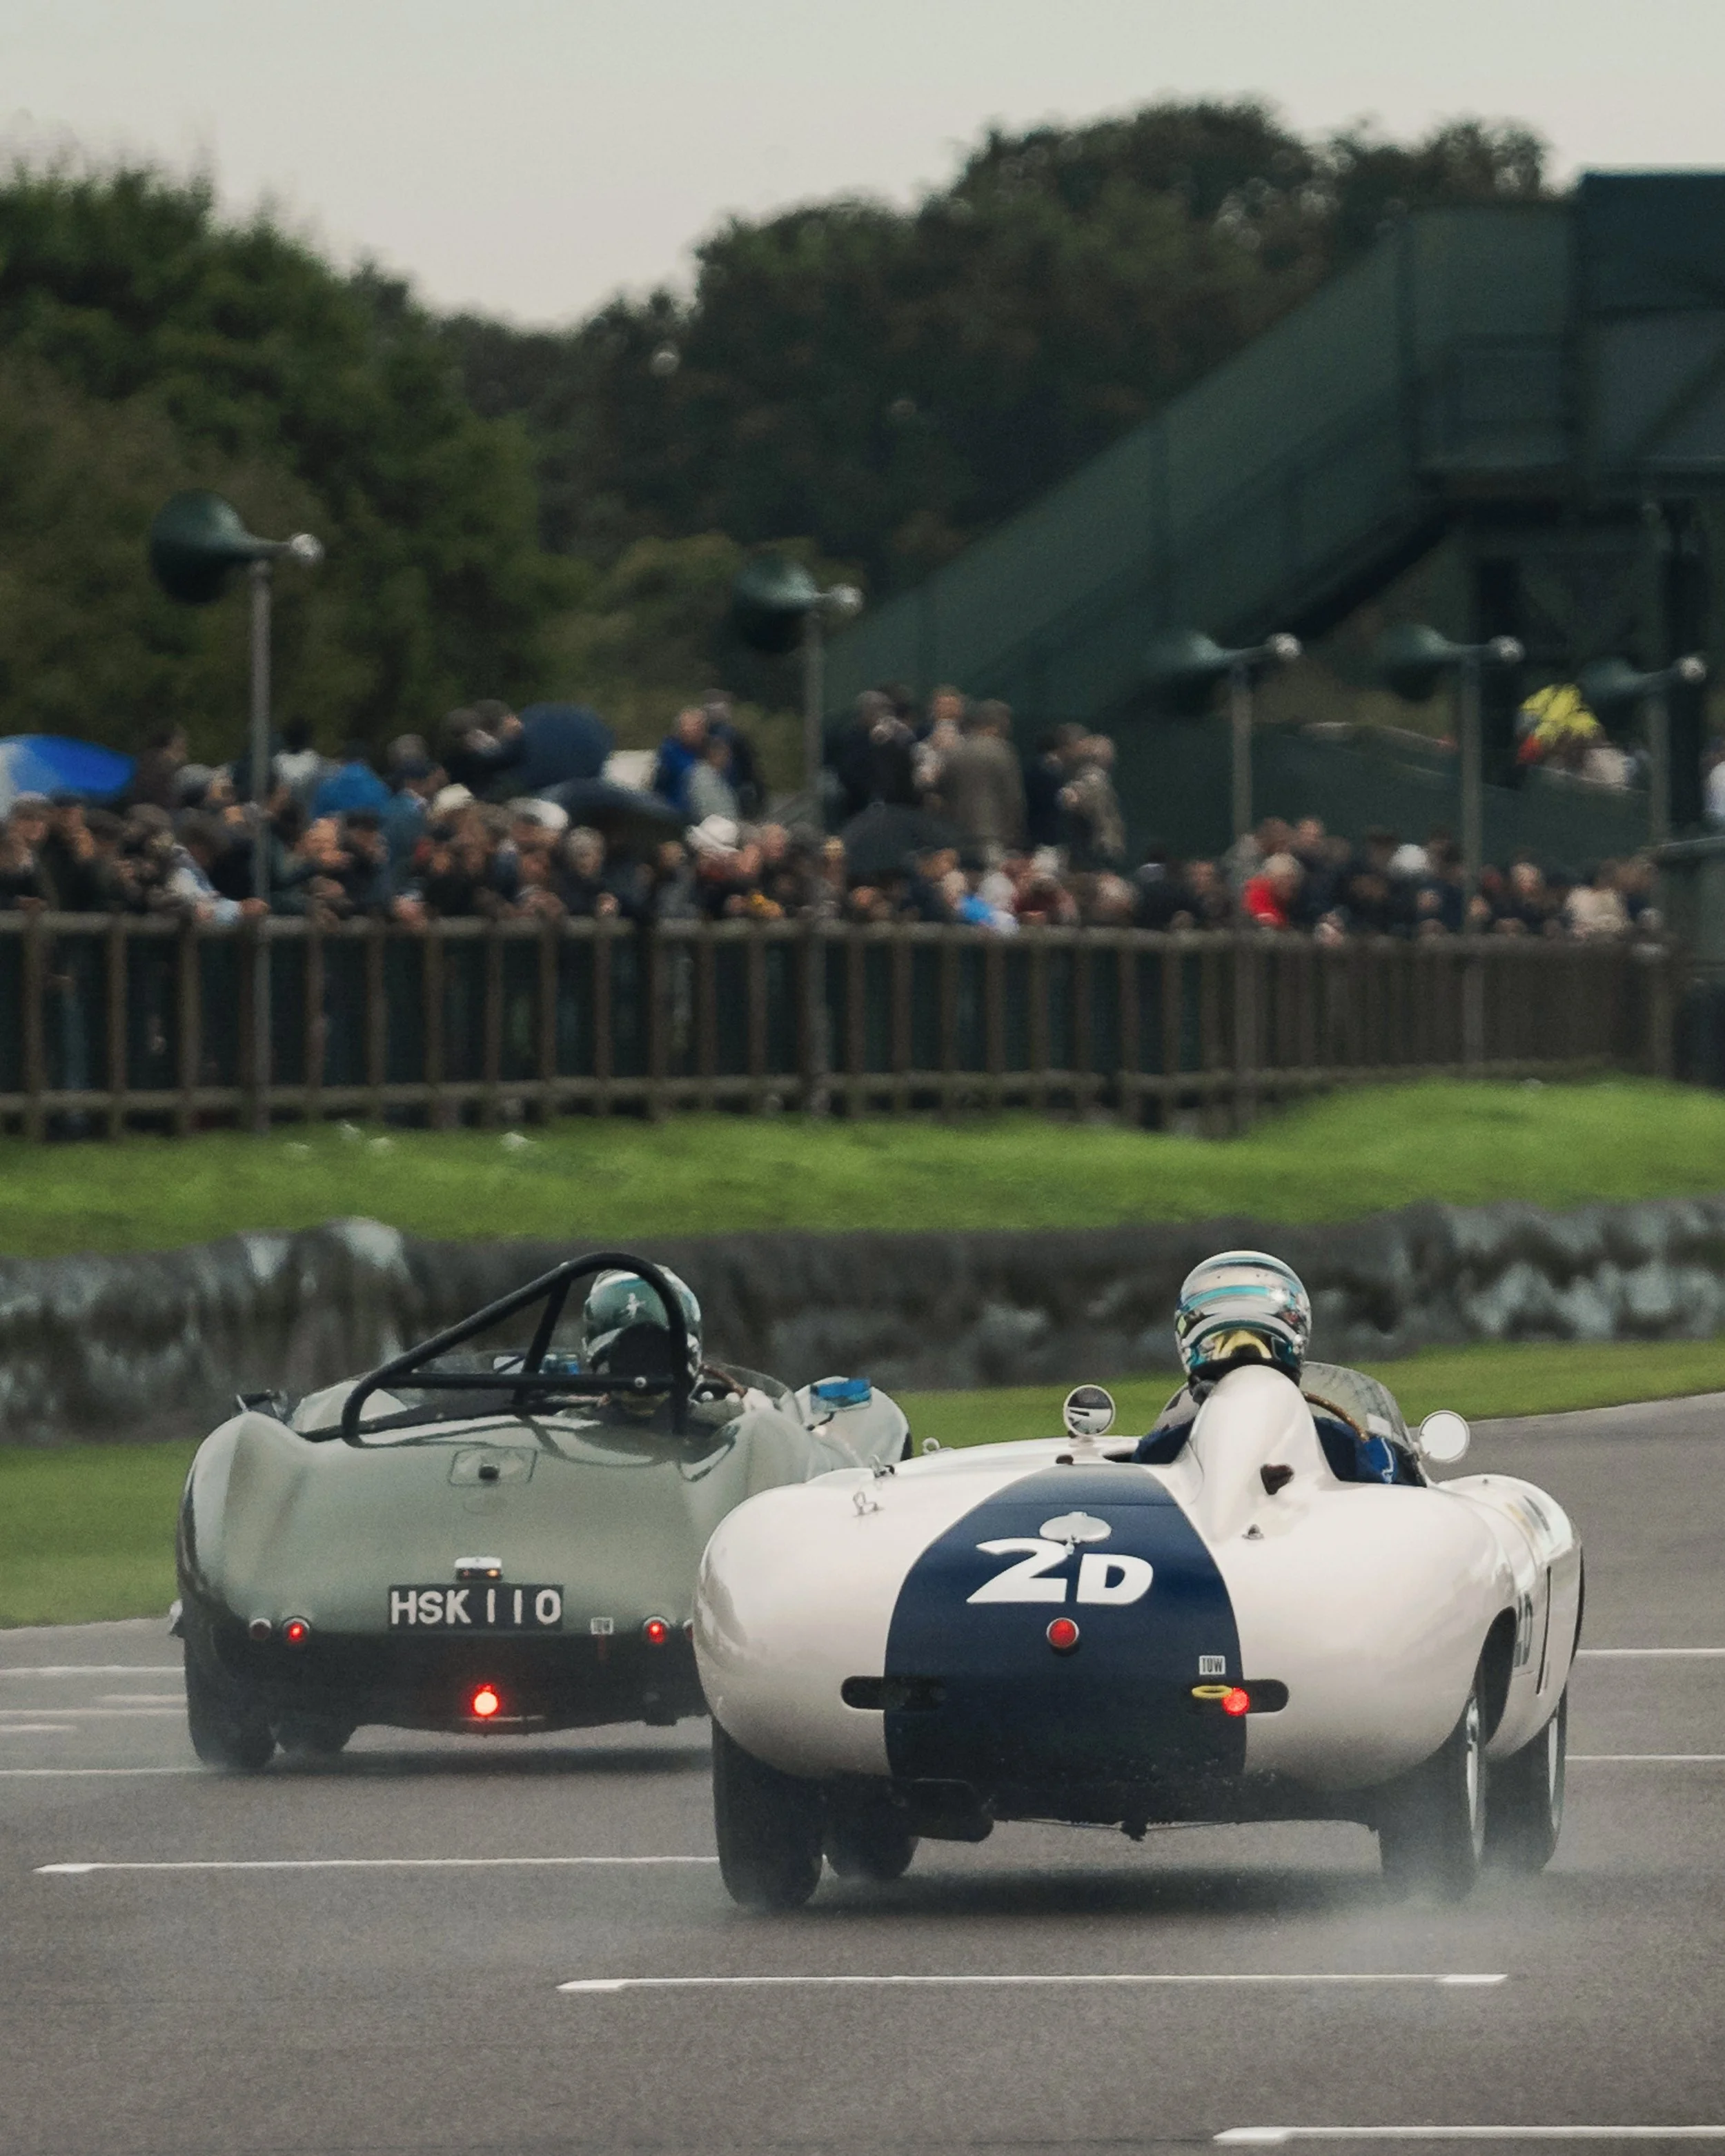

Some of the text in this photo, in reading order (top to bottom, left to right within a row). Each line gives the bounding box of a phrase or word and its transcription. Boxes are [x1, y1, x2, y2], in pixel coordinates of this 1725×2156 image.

[967, 1538, 1154, 1605] 2D
[391, 1588, 561, 1625] HSK 110
[1202, 1657, 1223, 1673] TOW
